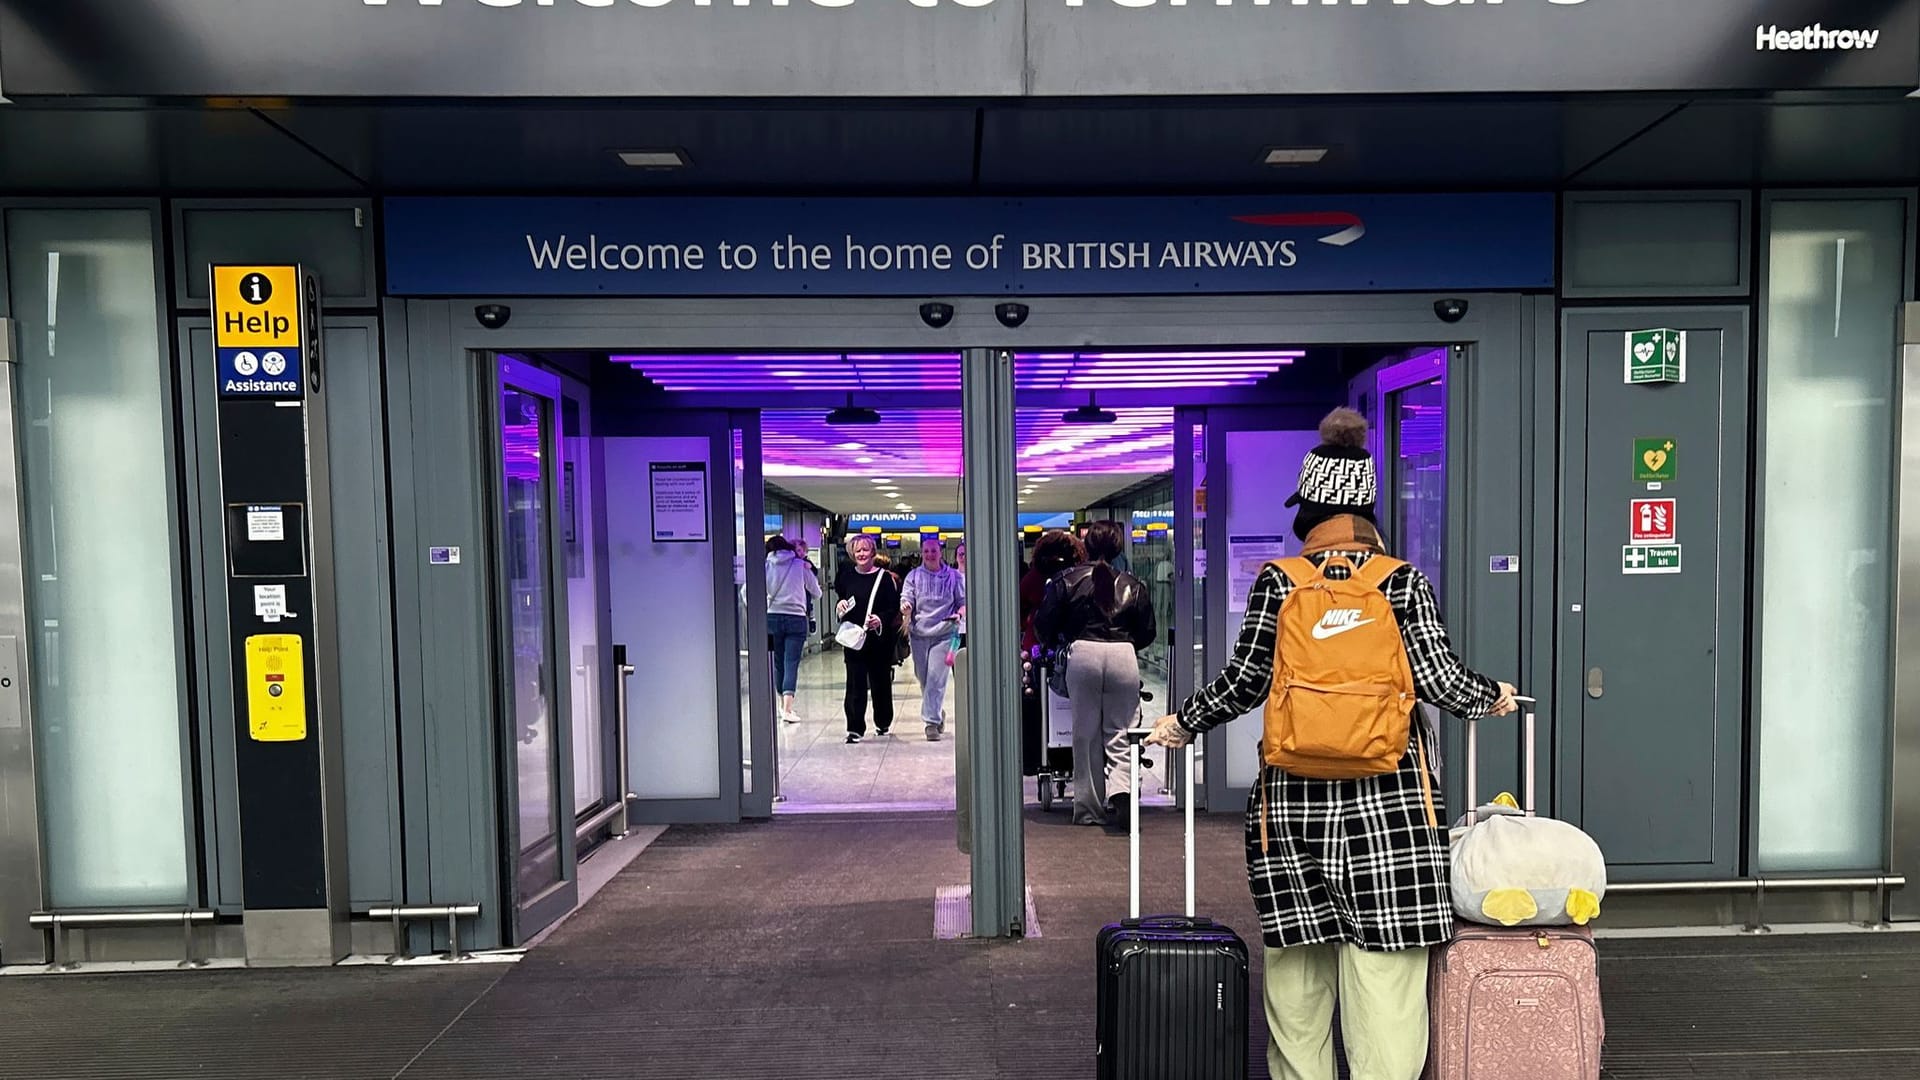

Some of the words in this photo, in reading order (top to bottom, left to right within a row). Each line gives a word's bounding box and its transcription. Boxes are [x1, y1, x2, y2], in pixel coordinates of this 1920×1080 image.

[1756, 23, 1879, 50] Heathrow
[526, 234, 704, 270] Welcome
[718, 240, 757, 270] to
[771, 234, 832, 270] the
[846, 234, 952, 270] home
[966, 234, 1005, 270] of
[1022, 242, 1150, 270] BRITISH
[1158, 240, 1297, 268] AIRWAYS
[225, 311, 290, 339] Help
[225, 379, 297, 392] Assistance
[1649, 549, 1678, 557] Trauma
[1658, 557, 1669, 566] kit
[1321, 609, 1363, 626] NIKE
